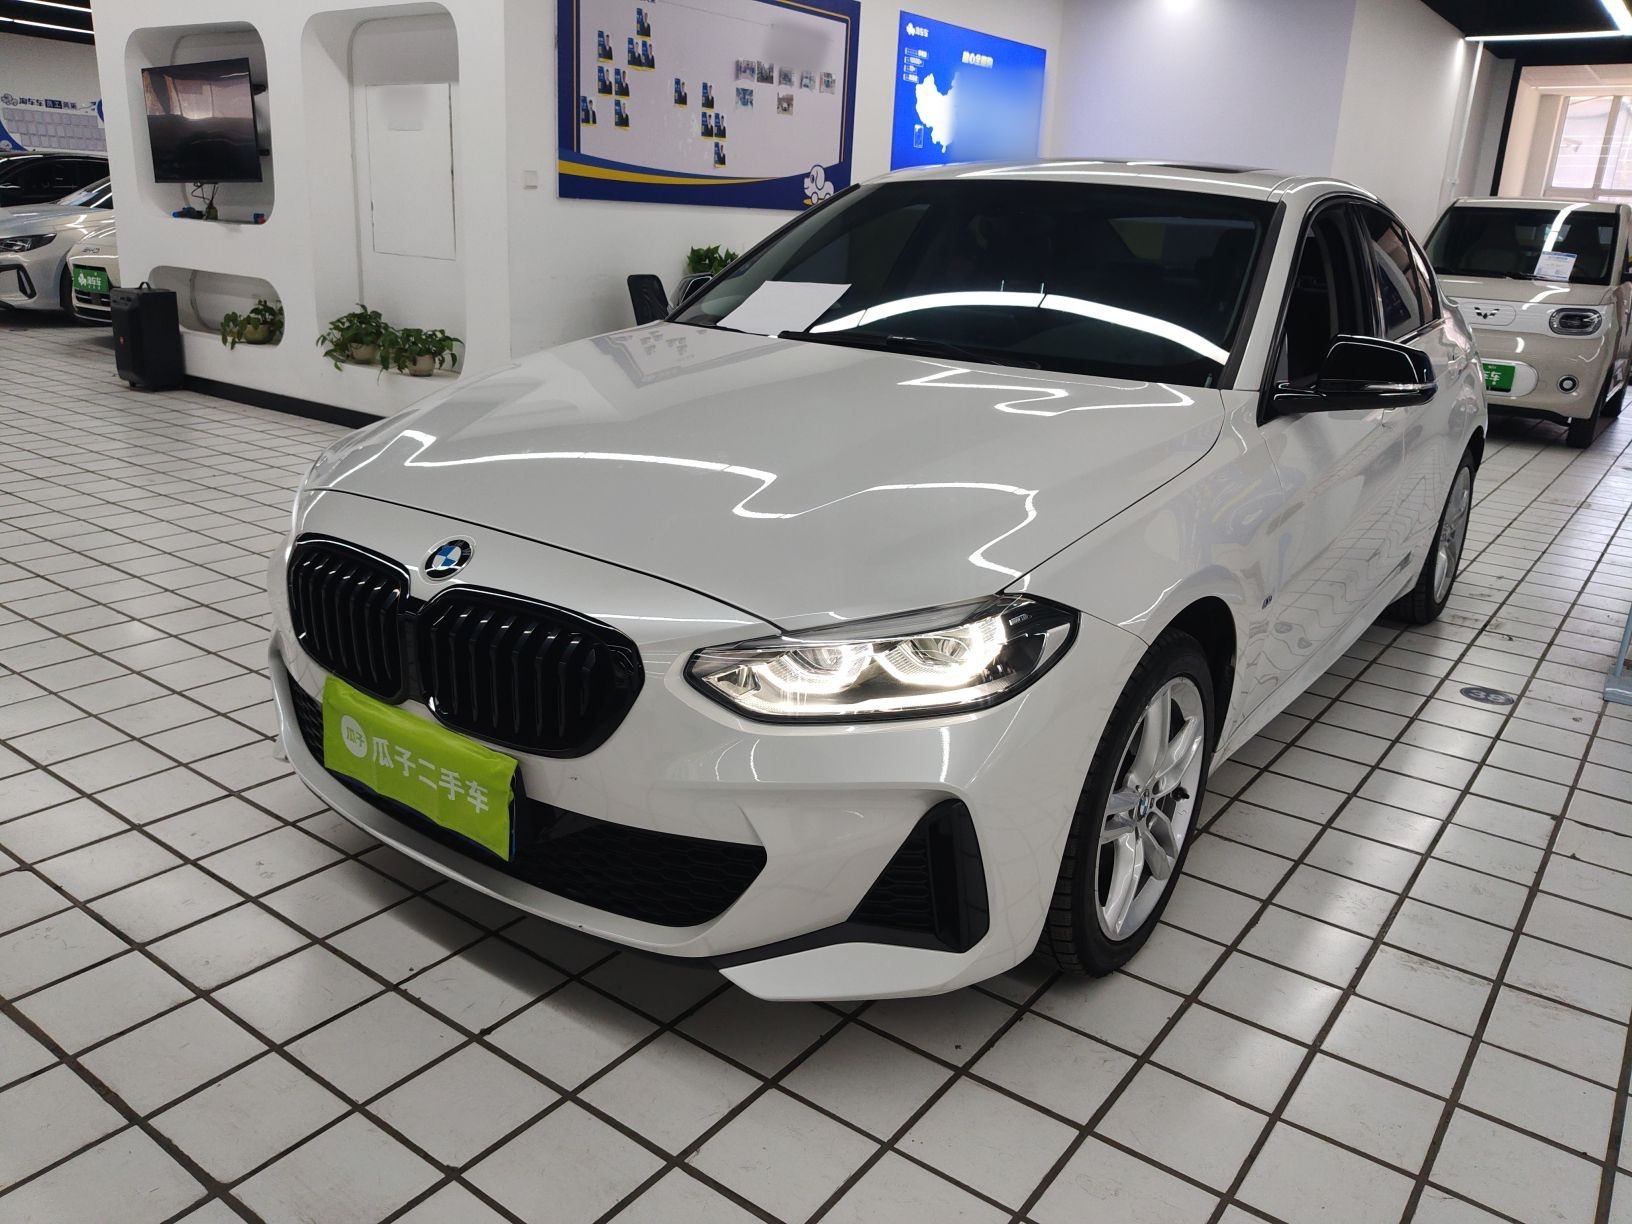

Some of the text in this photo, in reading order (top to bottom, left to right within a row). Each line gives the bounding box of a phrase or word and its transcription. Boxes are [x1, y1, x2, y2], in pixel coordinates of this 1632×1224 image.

[346, 726, 366, 748] 瓜子
[372, 736, 489, 814] 瓜子二手车
